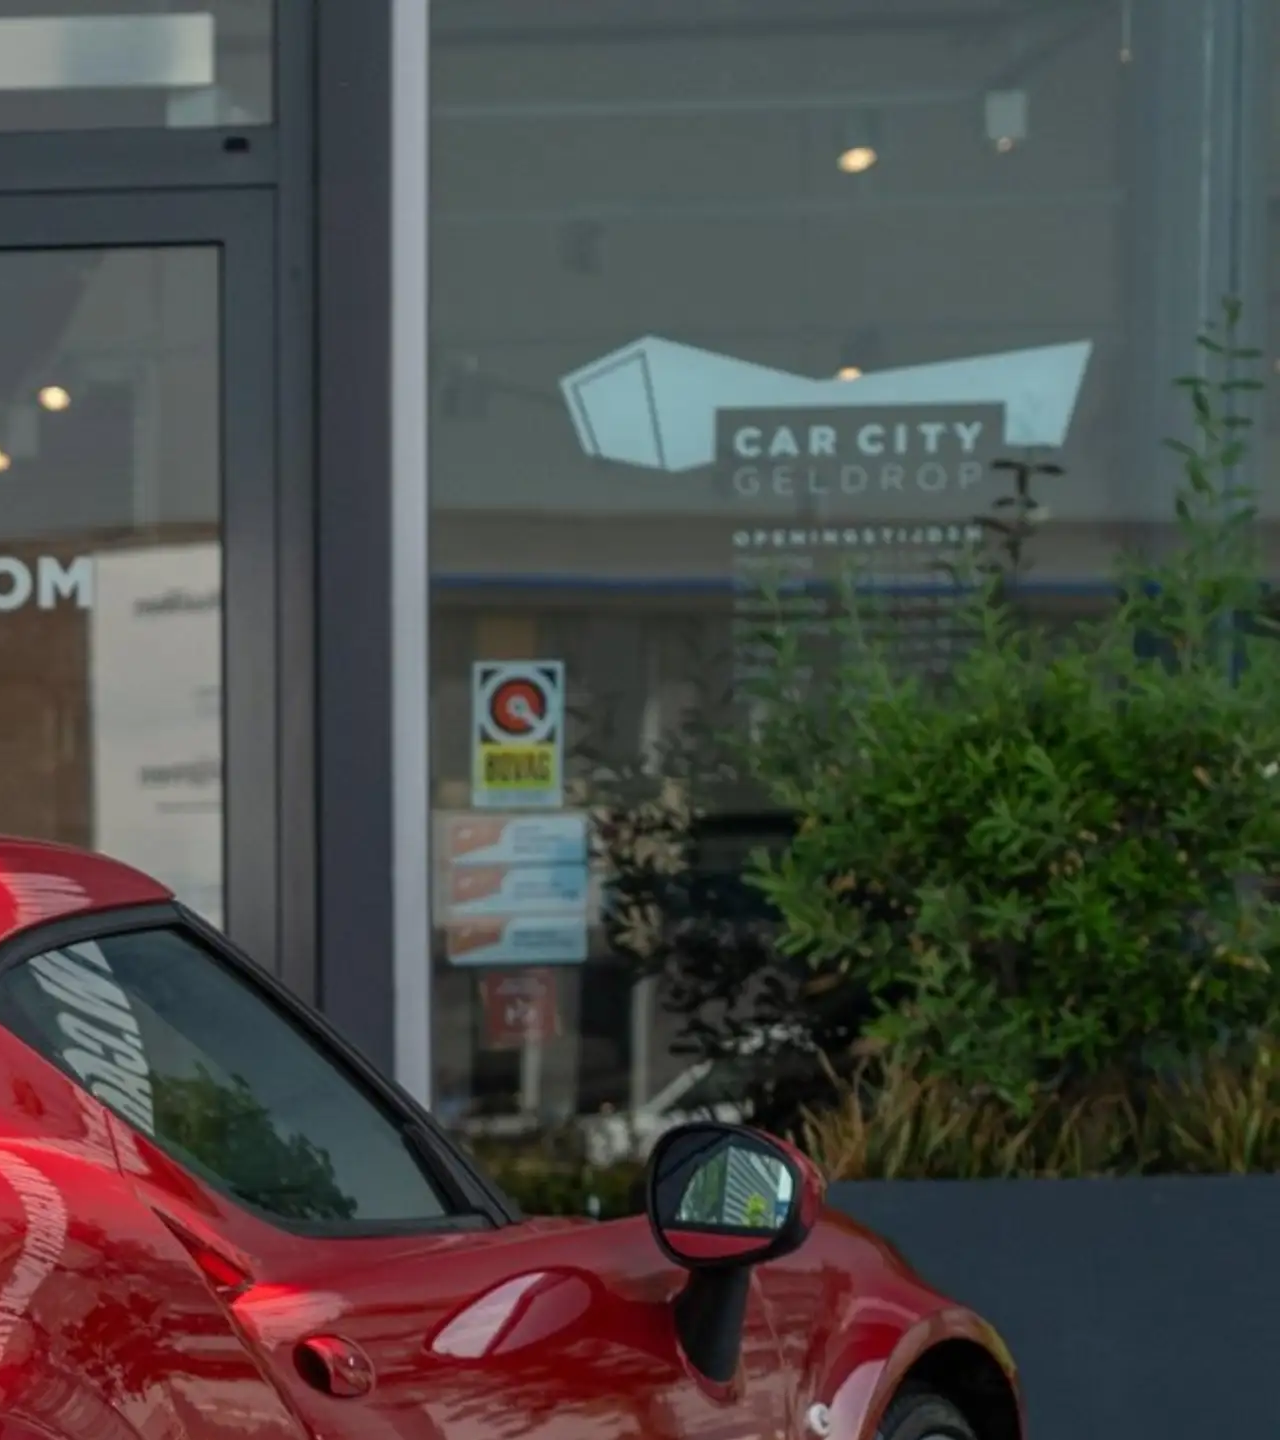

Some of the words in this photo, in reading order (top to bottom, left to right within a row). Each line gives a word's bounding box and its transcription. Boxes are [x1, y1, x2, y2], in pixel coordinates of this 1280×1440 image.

[734, 425, 838, 459] CAR
[856, 421, 983, 455] CITY
[733, 460, 983, 496] GELDROP
